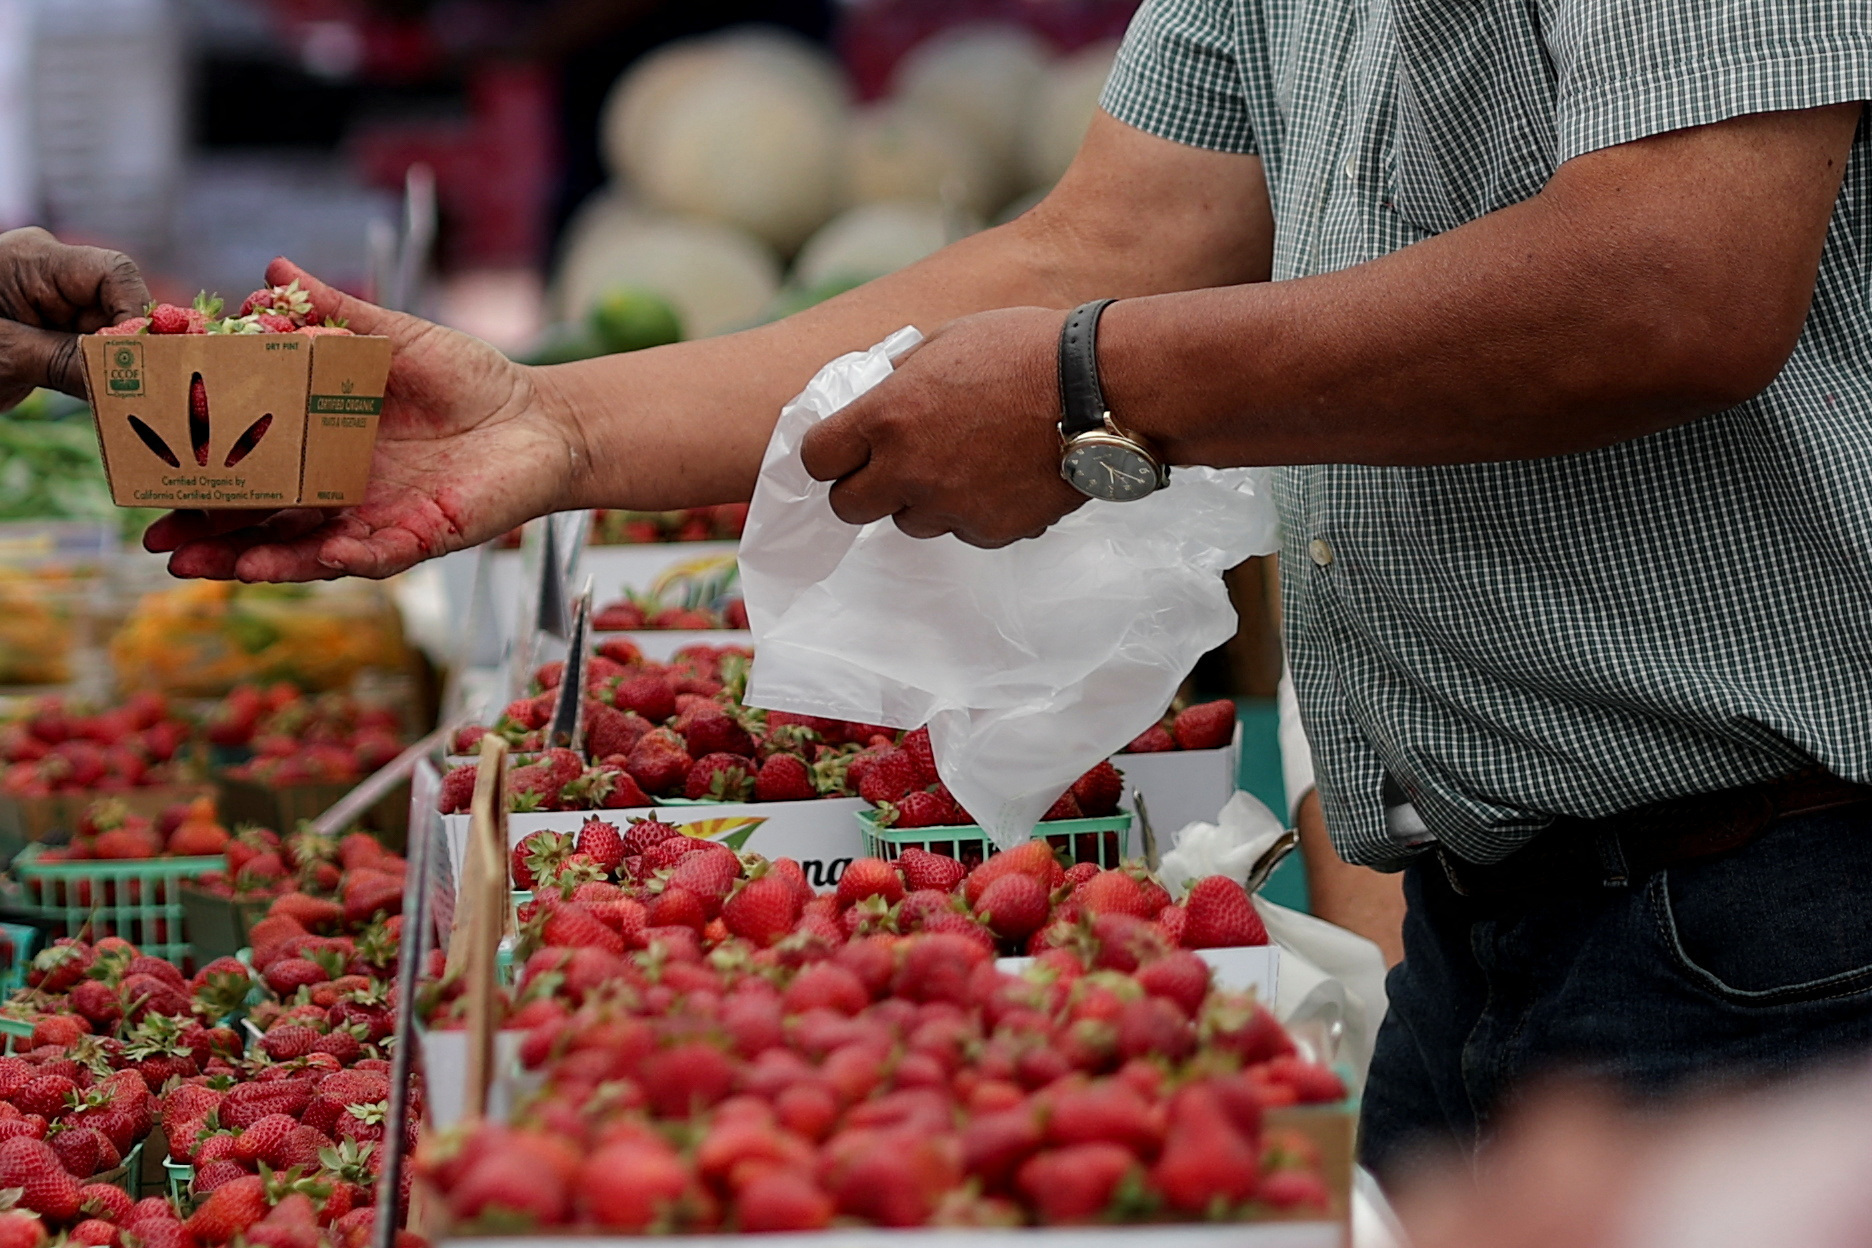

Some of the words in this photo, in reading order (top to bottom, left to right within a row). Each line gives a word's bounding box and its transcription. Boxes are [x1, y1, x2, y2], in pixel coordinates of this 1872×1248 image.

[283, 342, 299, 350] PINT
[317, 397, 345, 410] CERTIFIED
[345, 398, 375, 412] ORGANIC
[161, 475, 197, 486] Certified
[199, 475, 232, 488] Organic
[235, 475, 246, 488] by
[133, 489, 174, 500] California
[176, 489, 212, 500] Certified
[213, 489, 248, 502] Organic
[249, 489, 284, 500] Farmers
